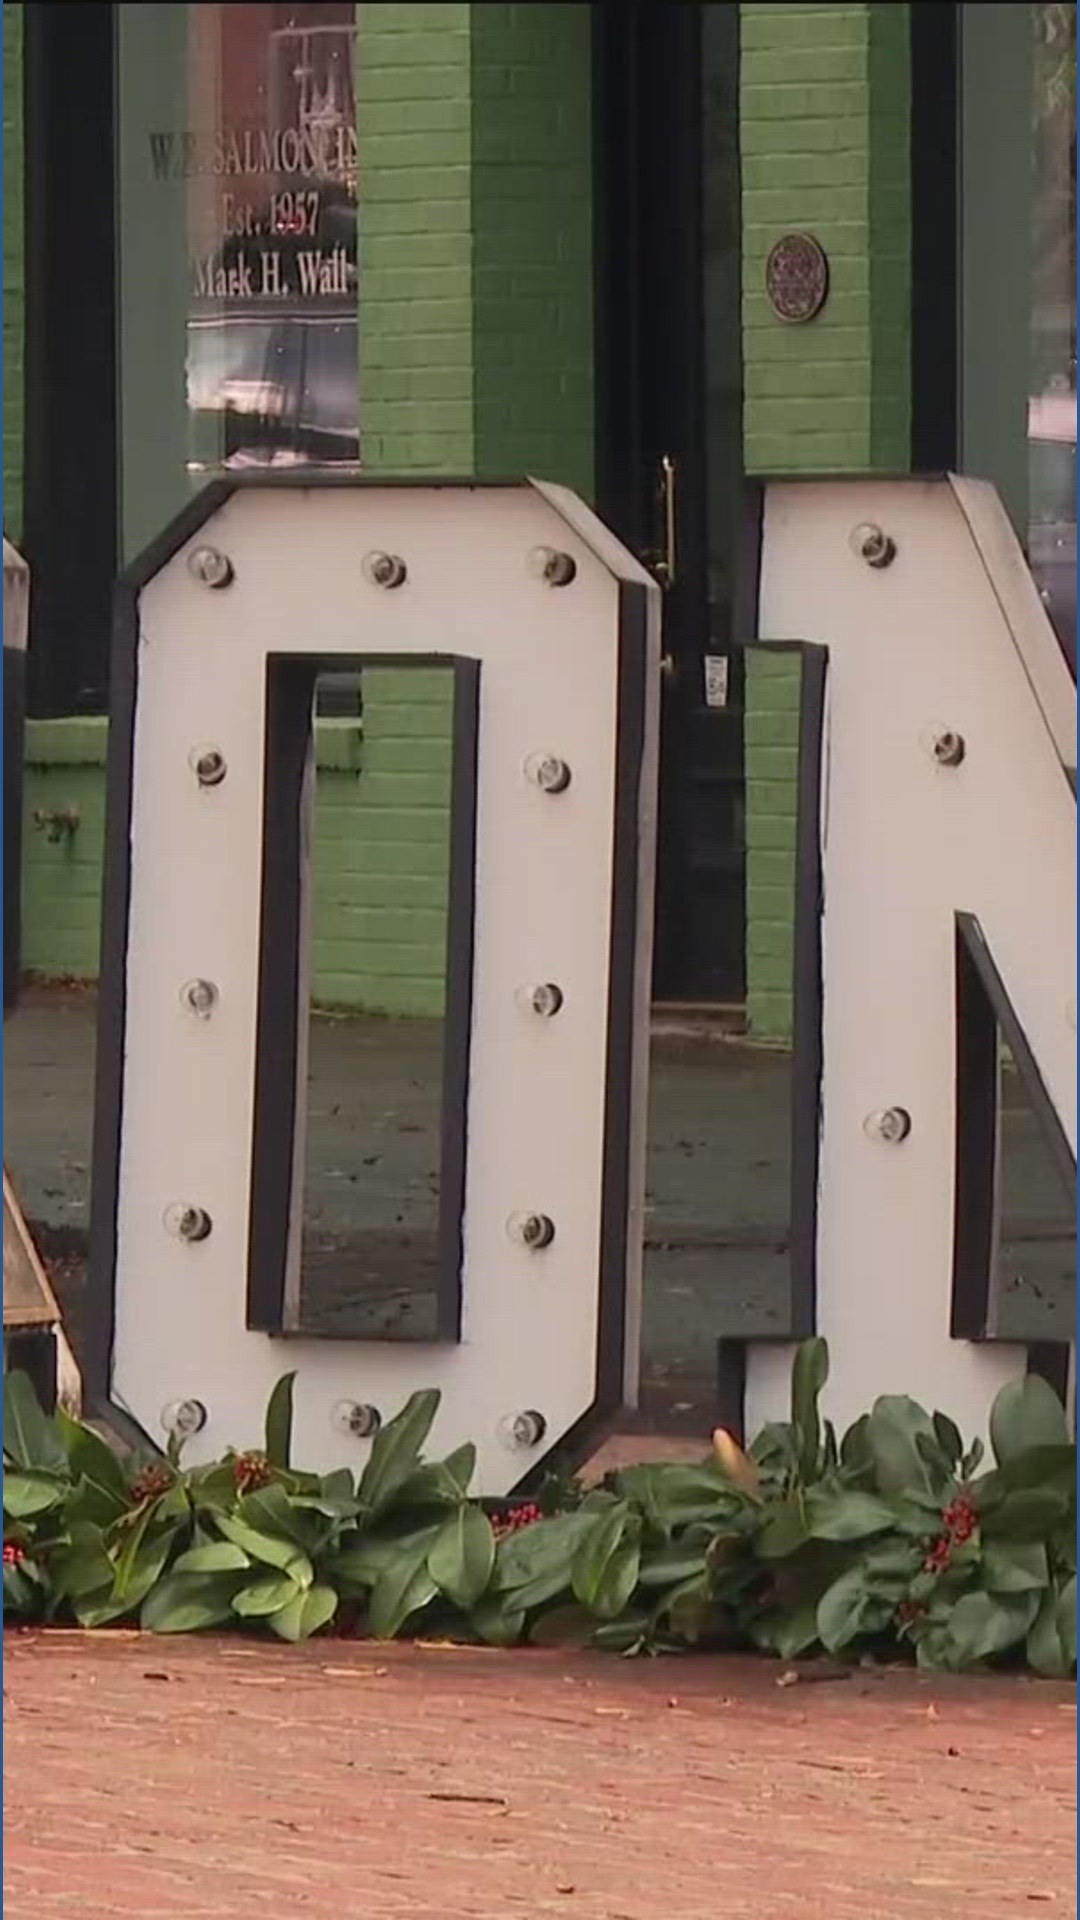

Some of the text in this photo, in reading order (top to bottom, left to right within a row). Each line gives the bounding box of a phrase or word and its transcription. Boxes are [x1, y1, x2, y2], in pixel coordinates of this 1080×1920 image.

[269, 192, 318, 236] 1957
[193, 250, 253, 297] Mark
[261, 251, 289, 296] H.
